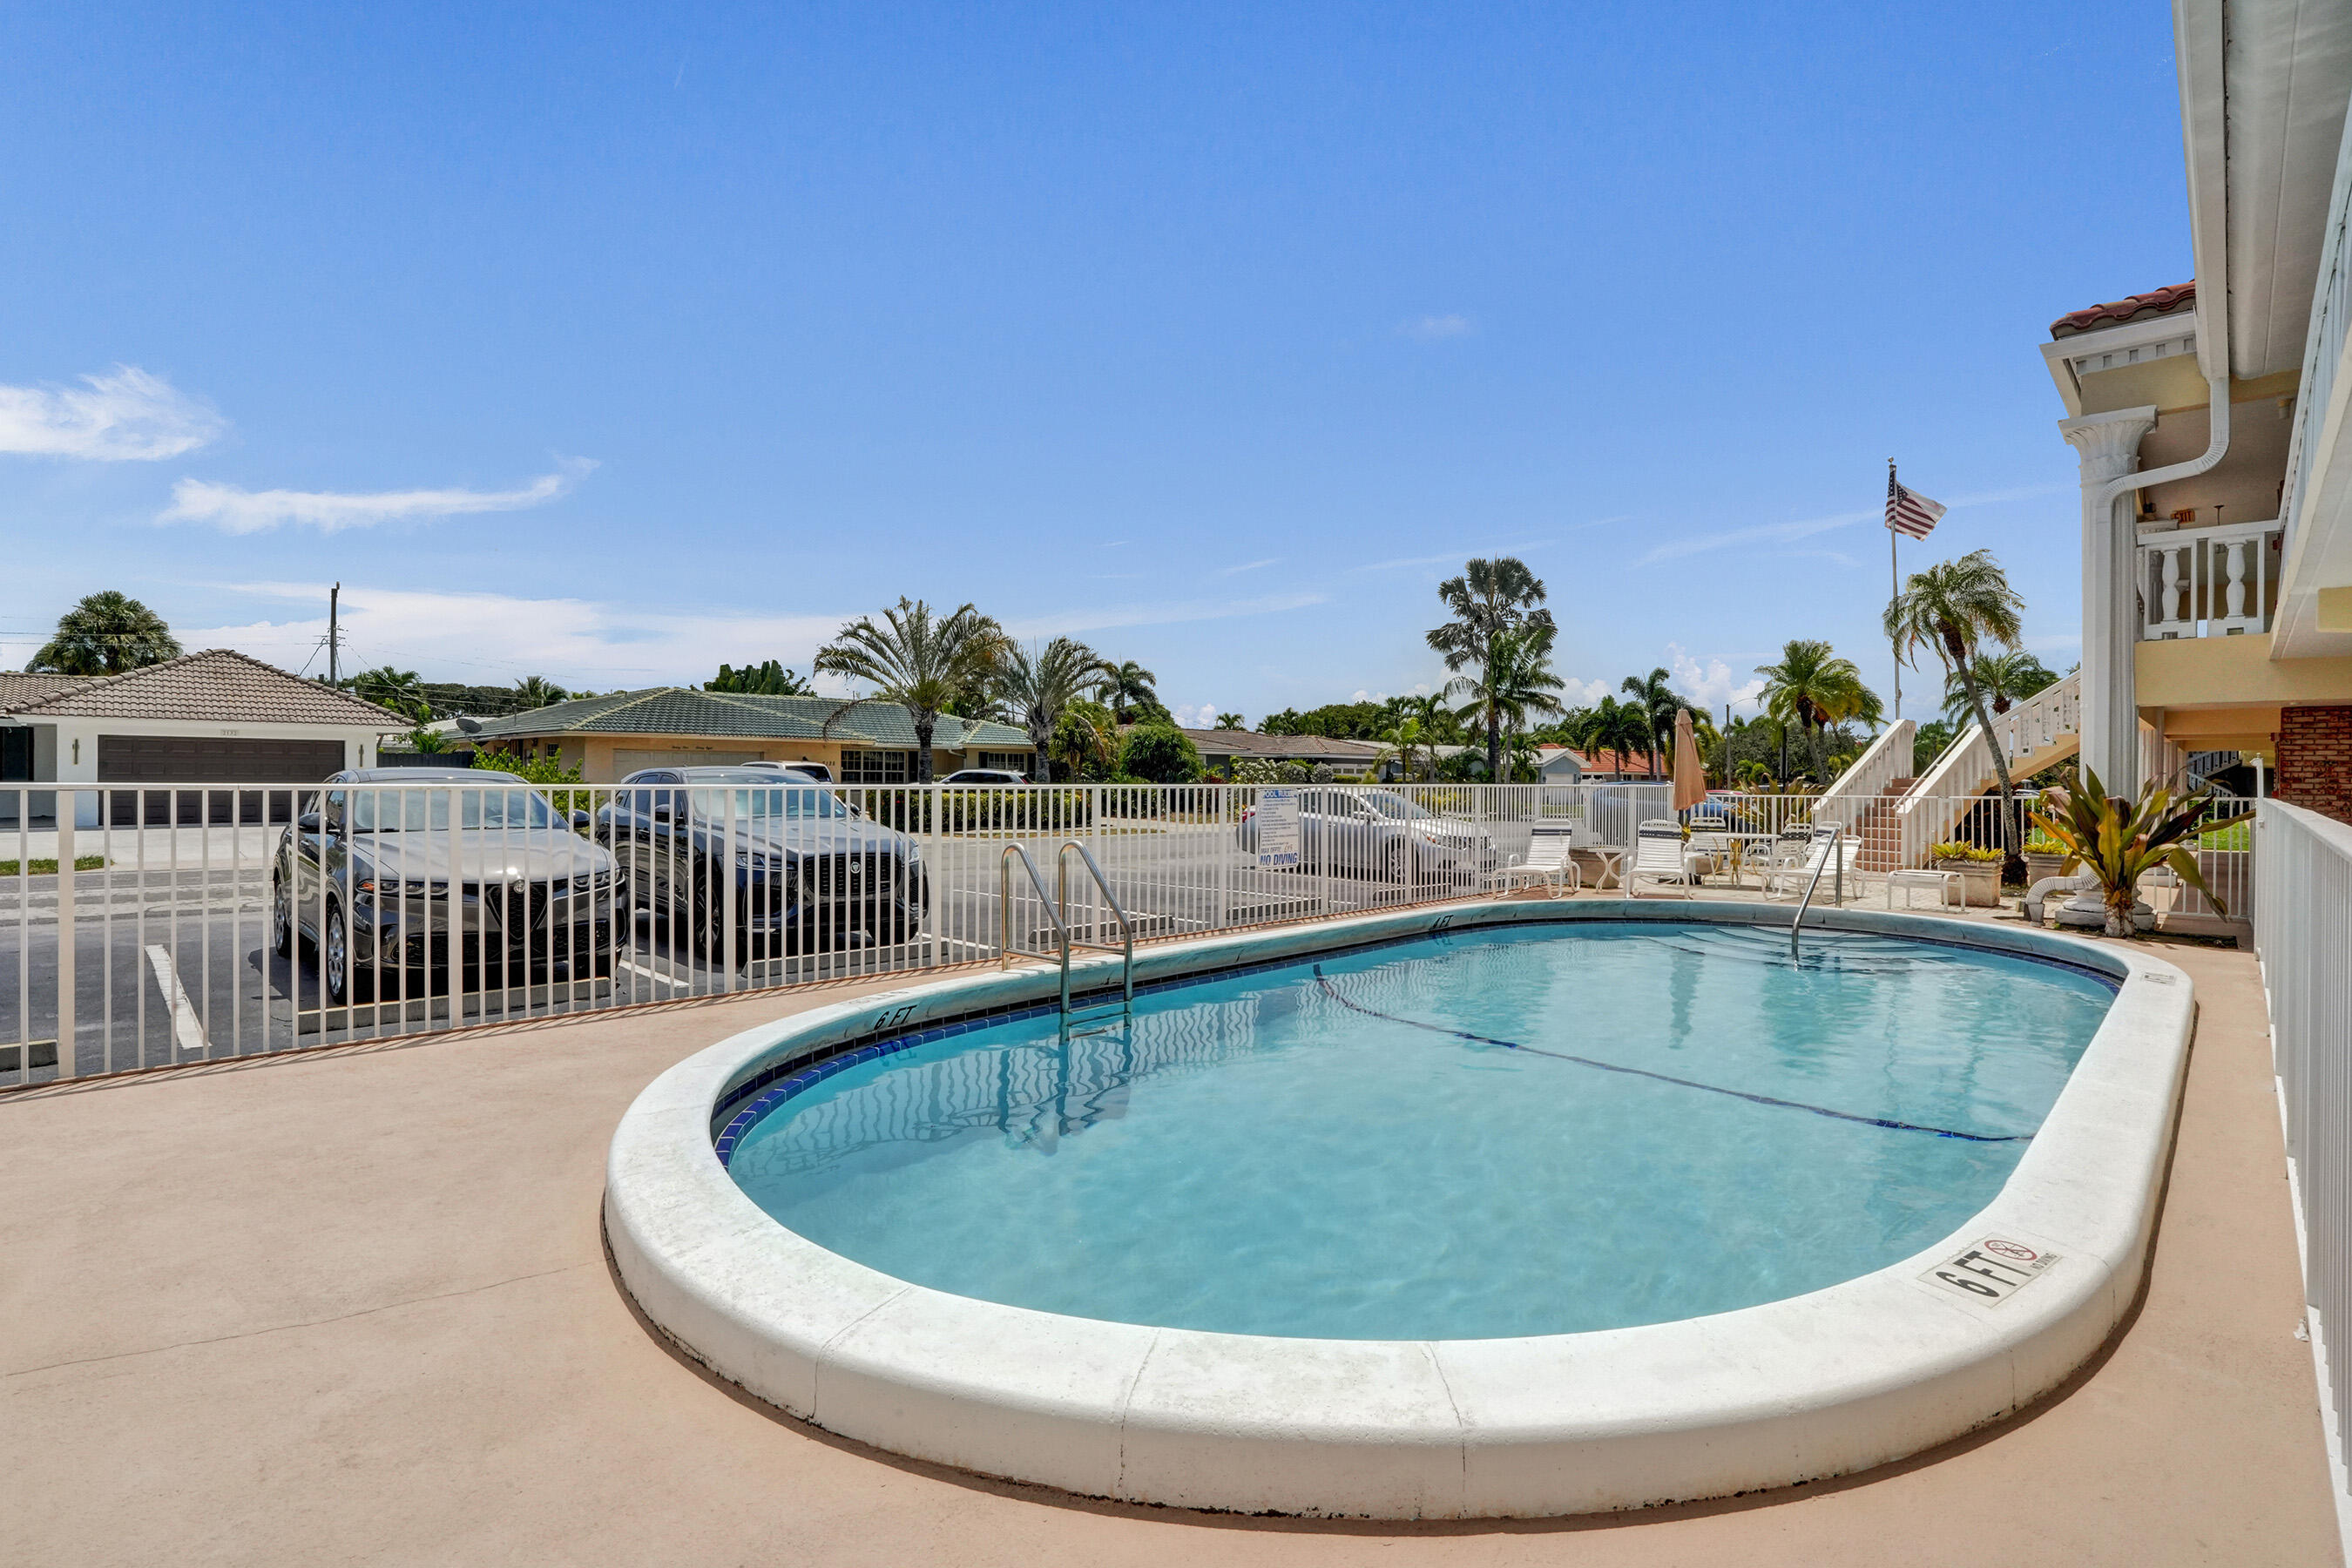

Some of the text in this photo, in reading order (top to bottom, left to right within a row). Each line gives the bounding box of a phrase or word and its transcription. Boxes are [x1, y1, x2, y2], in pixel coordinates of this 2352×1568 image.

[1260, 852, 1297, 866] NO DIVING
[873, 1004, 918, 1031] 6 FT
[1935, 1250, 2032, 1298] 6 FT
